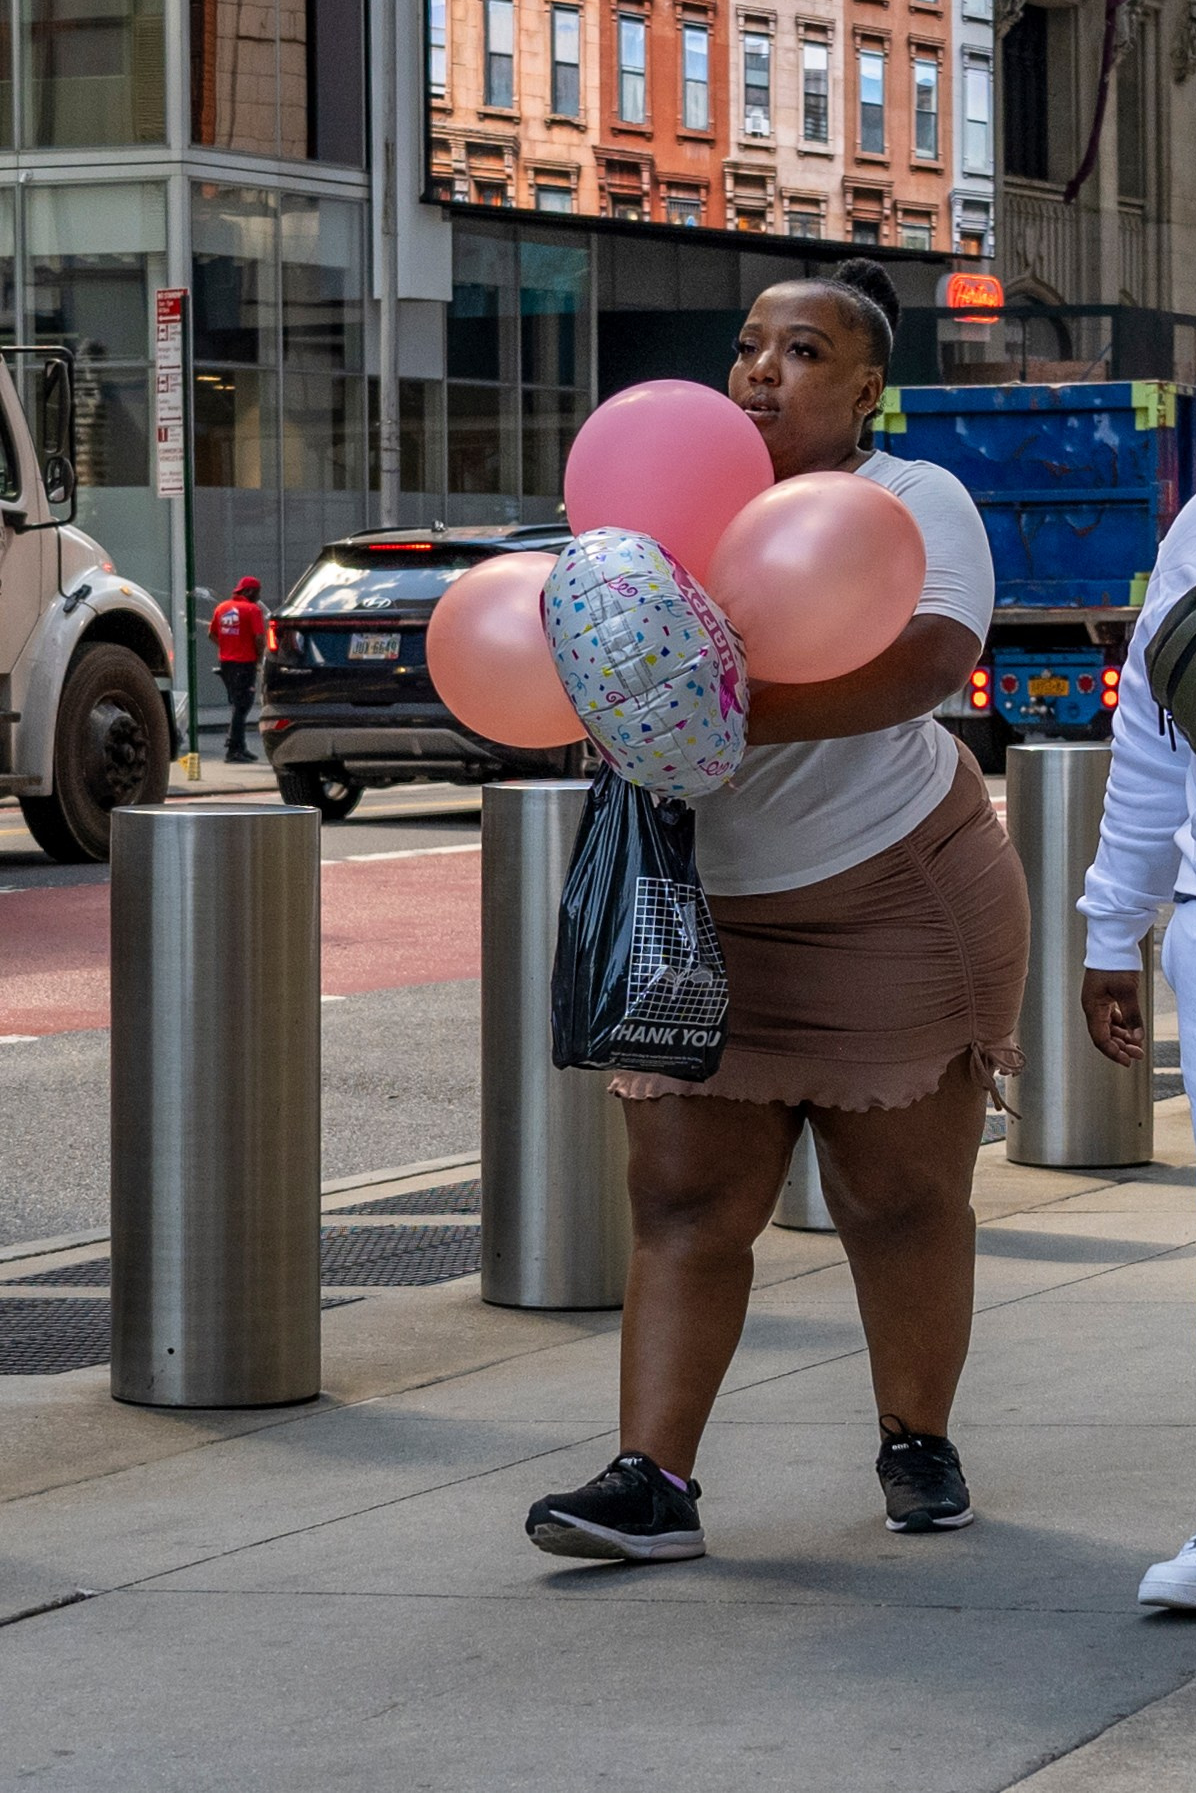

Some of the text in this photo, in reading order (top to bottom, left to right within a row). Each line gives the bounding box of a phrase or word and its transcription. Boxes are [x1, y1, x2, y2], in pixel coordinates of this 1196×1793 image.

[678, 583, 735, 672] HAPPY
[609, 1024, 721, 1047] THANK YOU
